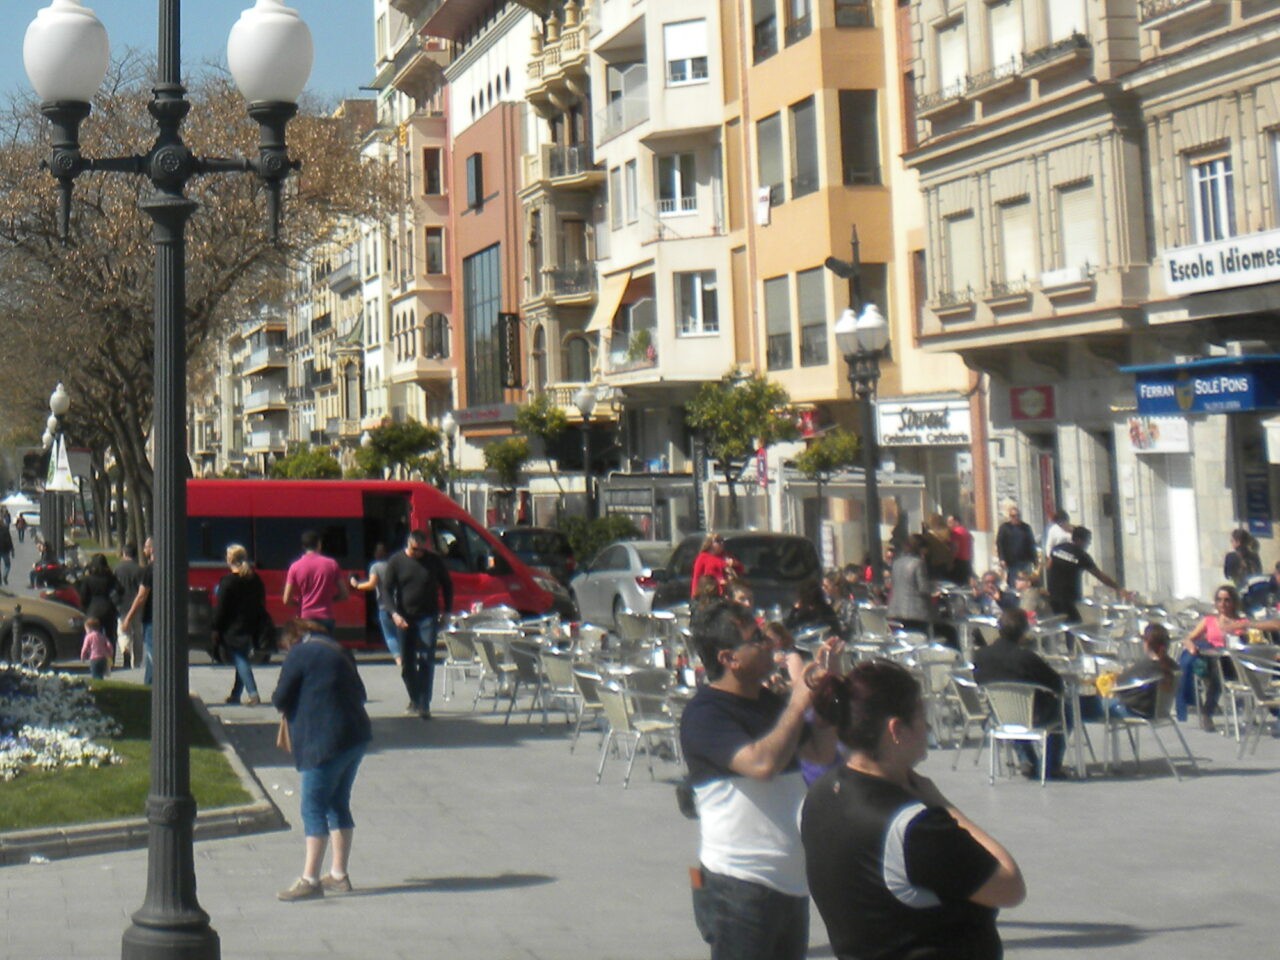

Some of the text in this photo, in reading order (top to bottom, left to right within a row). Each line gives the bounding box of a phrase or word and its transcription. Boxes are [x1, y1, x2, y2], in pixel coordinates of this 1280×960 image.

[1169, 253, 1214, 282] Escola
[1140, 384, 1175, 398] FERRAN
[1220, 376, 1248, 392] PONS
